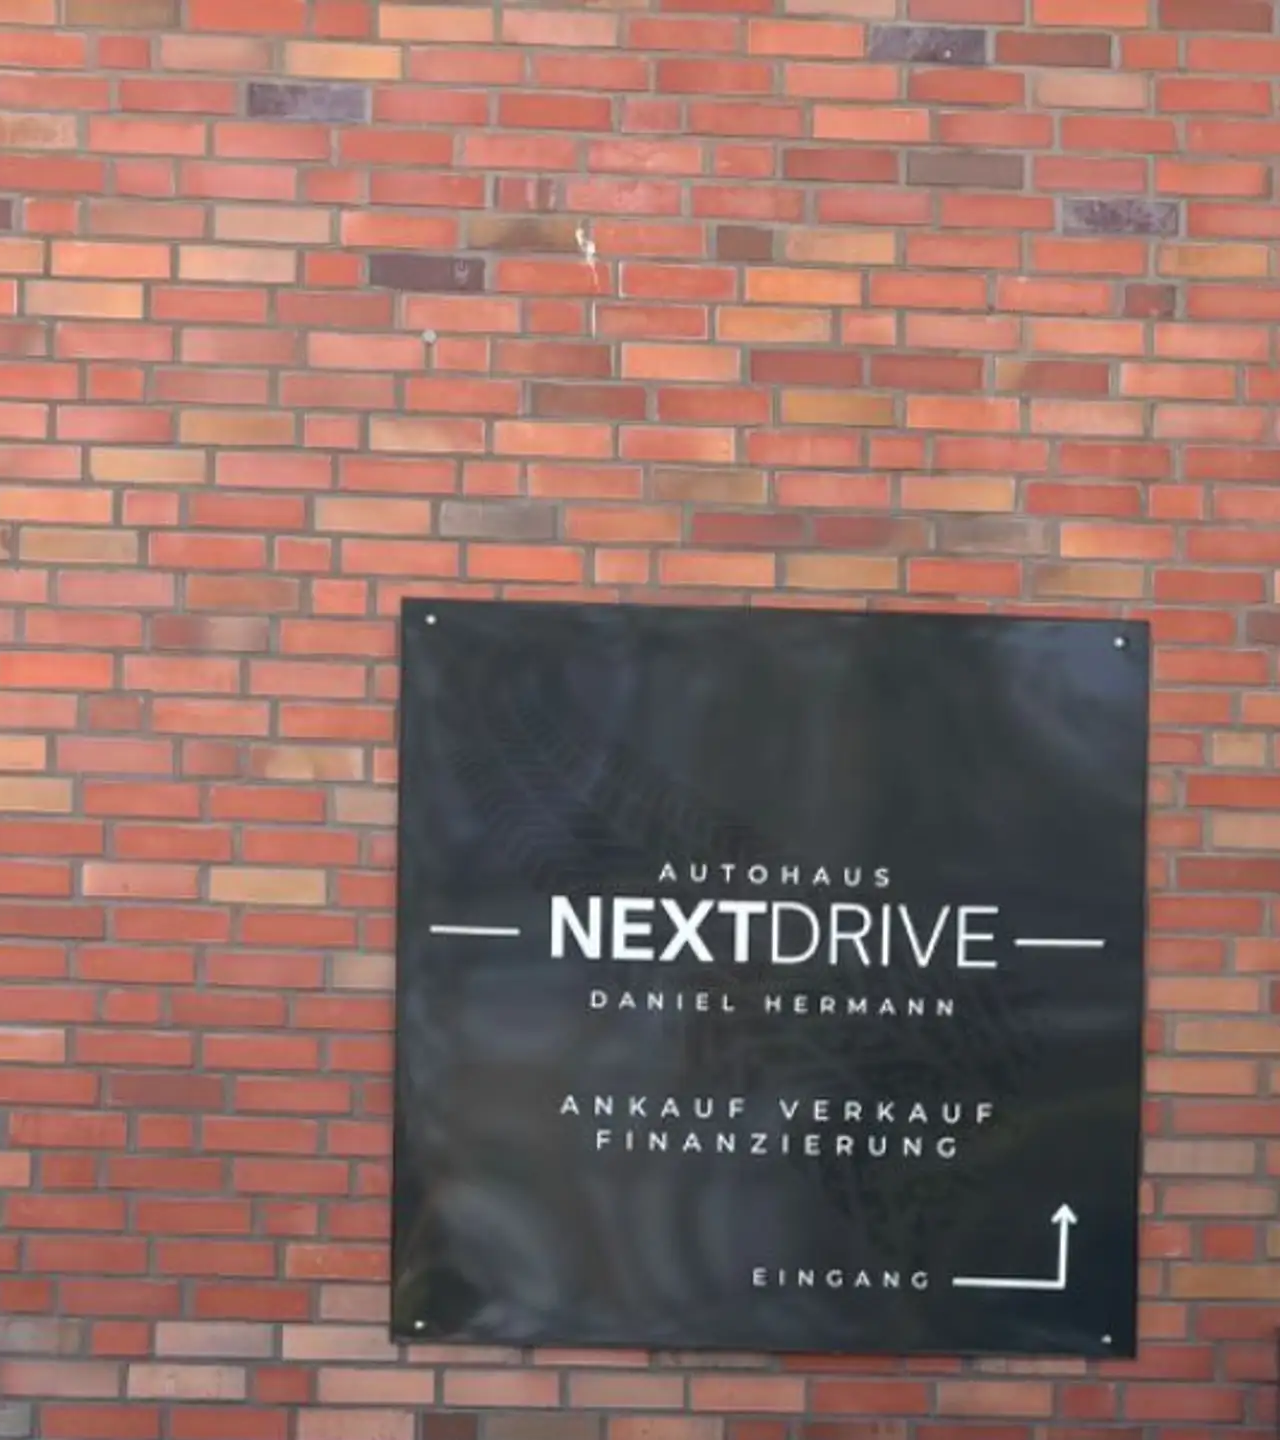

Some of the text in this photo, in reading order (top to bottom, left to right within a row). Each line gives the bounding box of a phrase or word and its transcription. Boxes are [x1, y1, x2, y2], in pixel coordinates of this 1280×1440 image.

[658, 862, 891, 889] AUTOHAUS
[550, 896, 999, 969] NEXTDRIVE
[589, 989, 955, 1018] DANIEL HERMANN
[559, 1094, 993, 1124] ANKAUF VERKAUF
[596, 1129, 957, 1159] FINANZIERUNG
[752, 1267, 929, 1290] EINGANG
